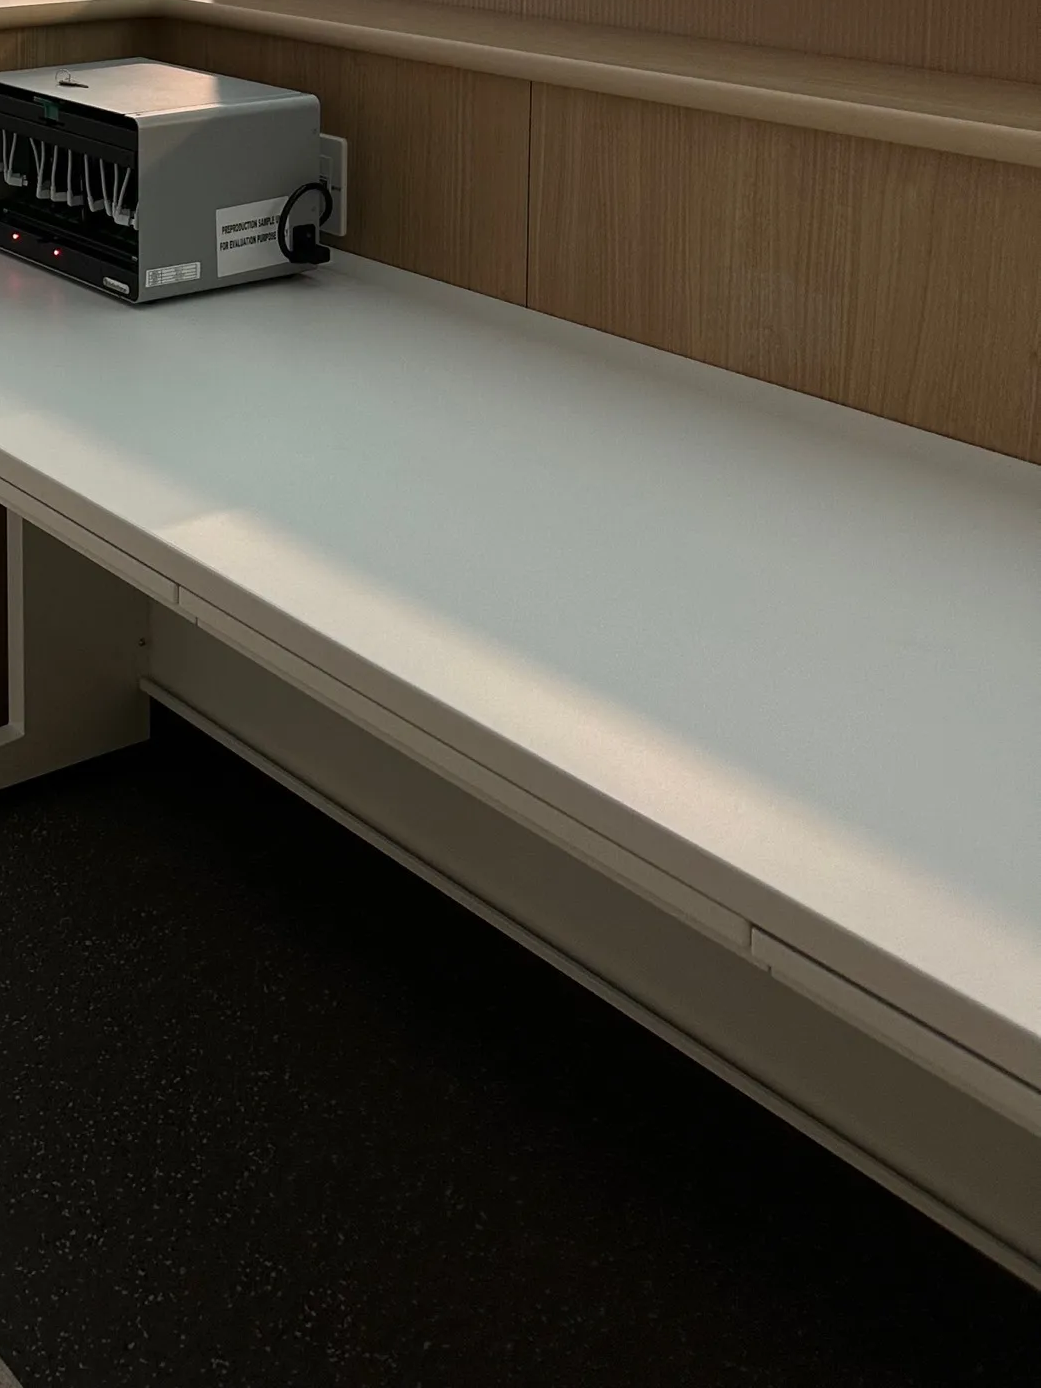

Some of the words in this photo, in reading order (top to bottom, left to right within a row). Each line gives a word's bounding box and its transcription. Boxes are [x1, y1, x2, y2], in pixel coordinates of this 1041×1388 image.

[258, 215, 275, 228] SAMPLE
[219, 241, 229, 251] FOR
[229, 235, 257, 249] EVALUATION
